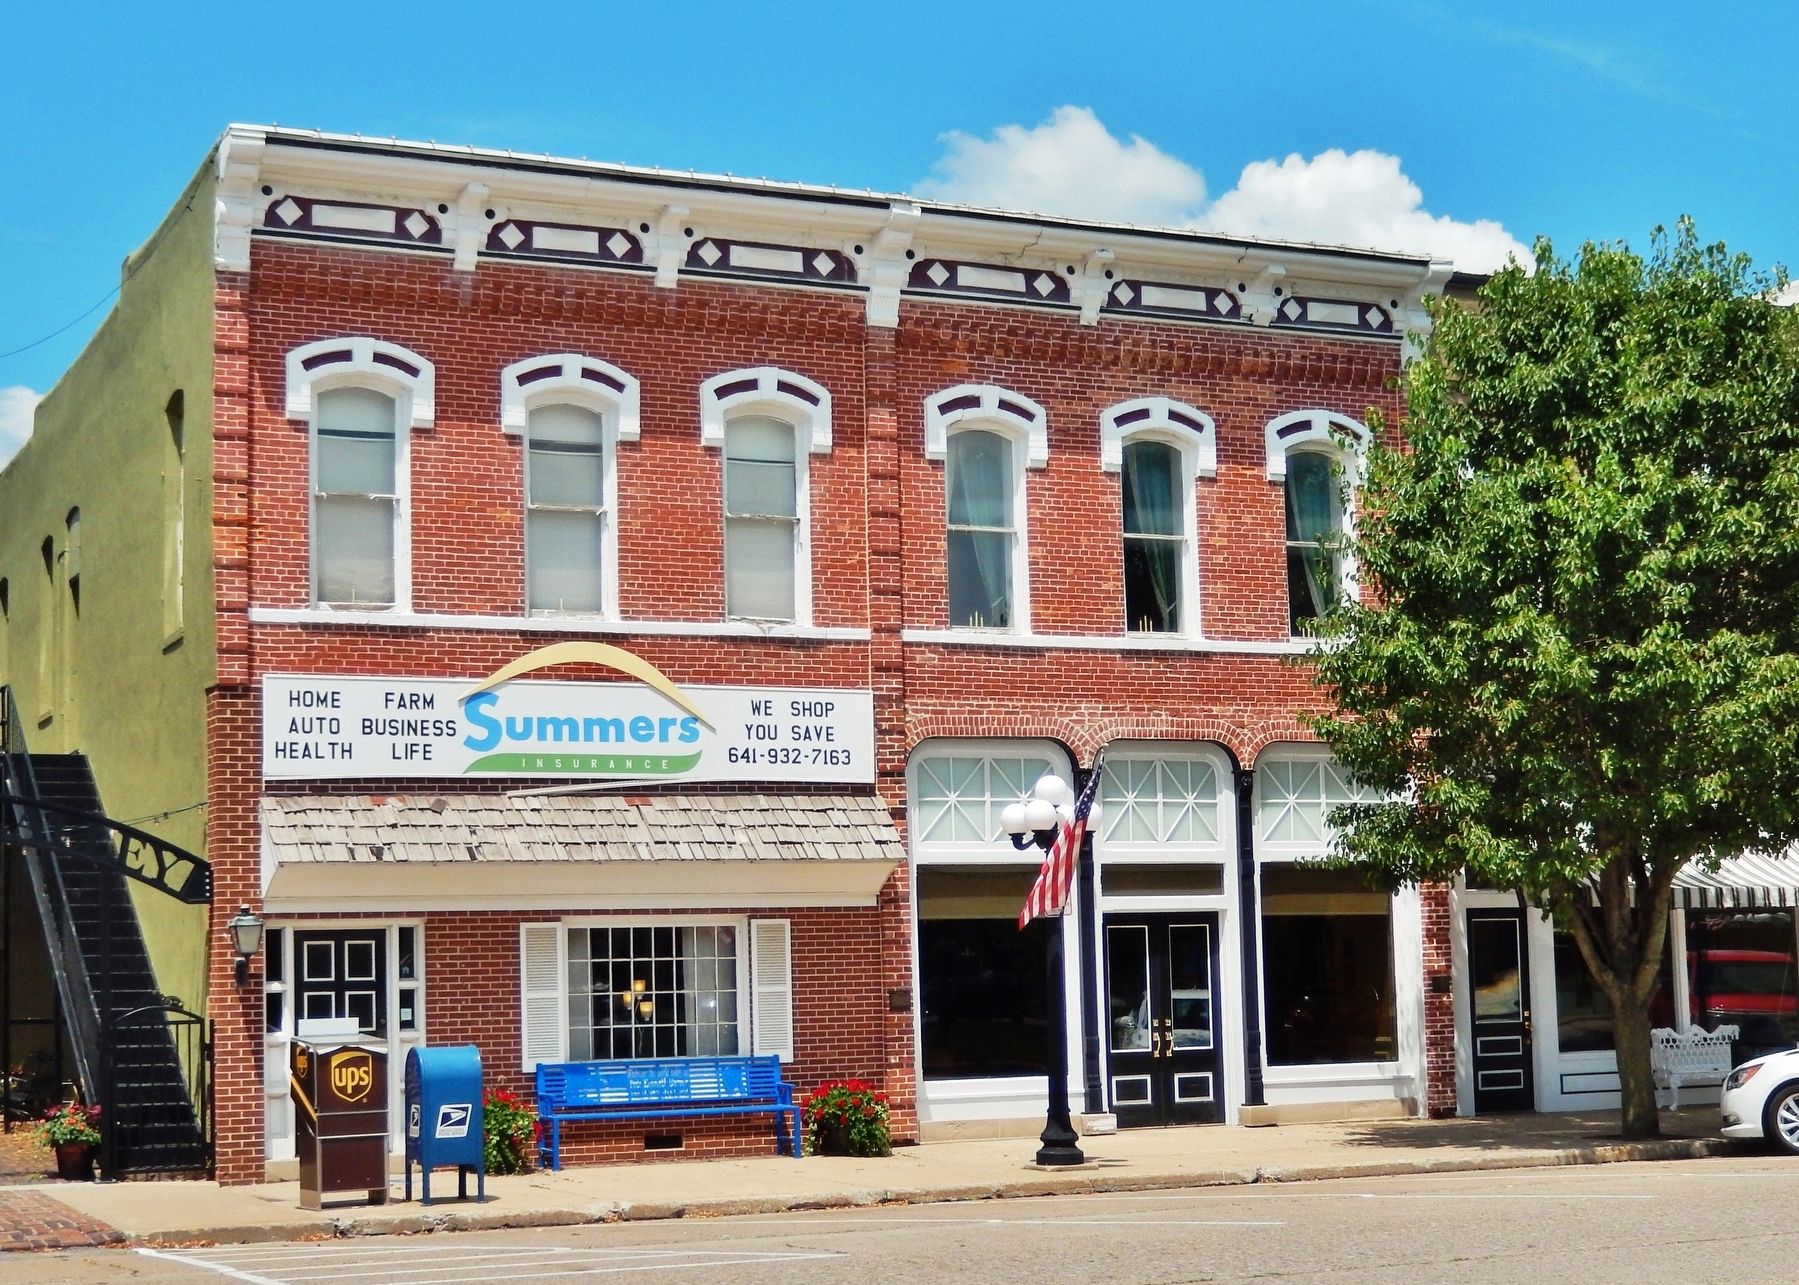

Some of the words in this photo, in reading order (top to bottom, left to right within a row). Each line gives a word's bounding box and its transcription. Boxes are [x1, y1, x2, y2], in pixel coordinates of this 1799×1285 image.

[288, 689, 341, 709] HOME
[384, 692, 435, 710] FARM
[751, 699, 773, 716] WE
[790, 701, 835, 718] SHOP
[288, 717, 341, 735] AUTO
[361, 718, 457, 737] BUSINESS
[463, 691, 700, 752] Summers
[745, 724, 778, 740] YOU
[791, 725, 835, 742] SAVE
[274, 741, 353, 760] HEALTH
[392, 742, 433, 761] LIFE
[728, 747, 851, 765] 641-932-7163
[521, 758, 669, 770] INSURANCE
[334, 1066, 370, 1094] ups
